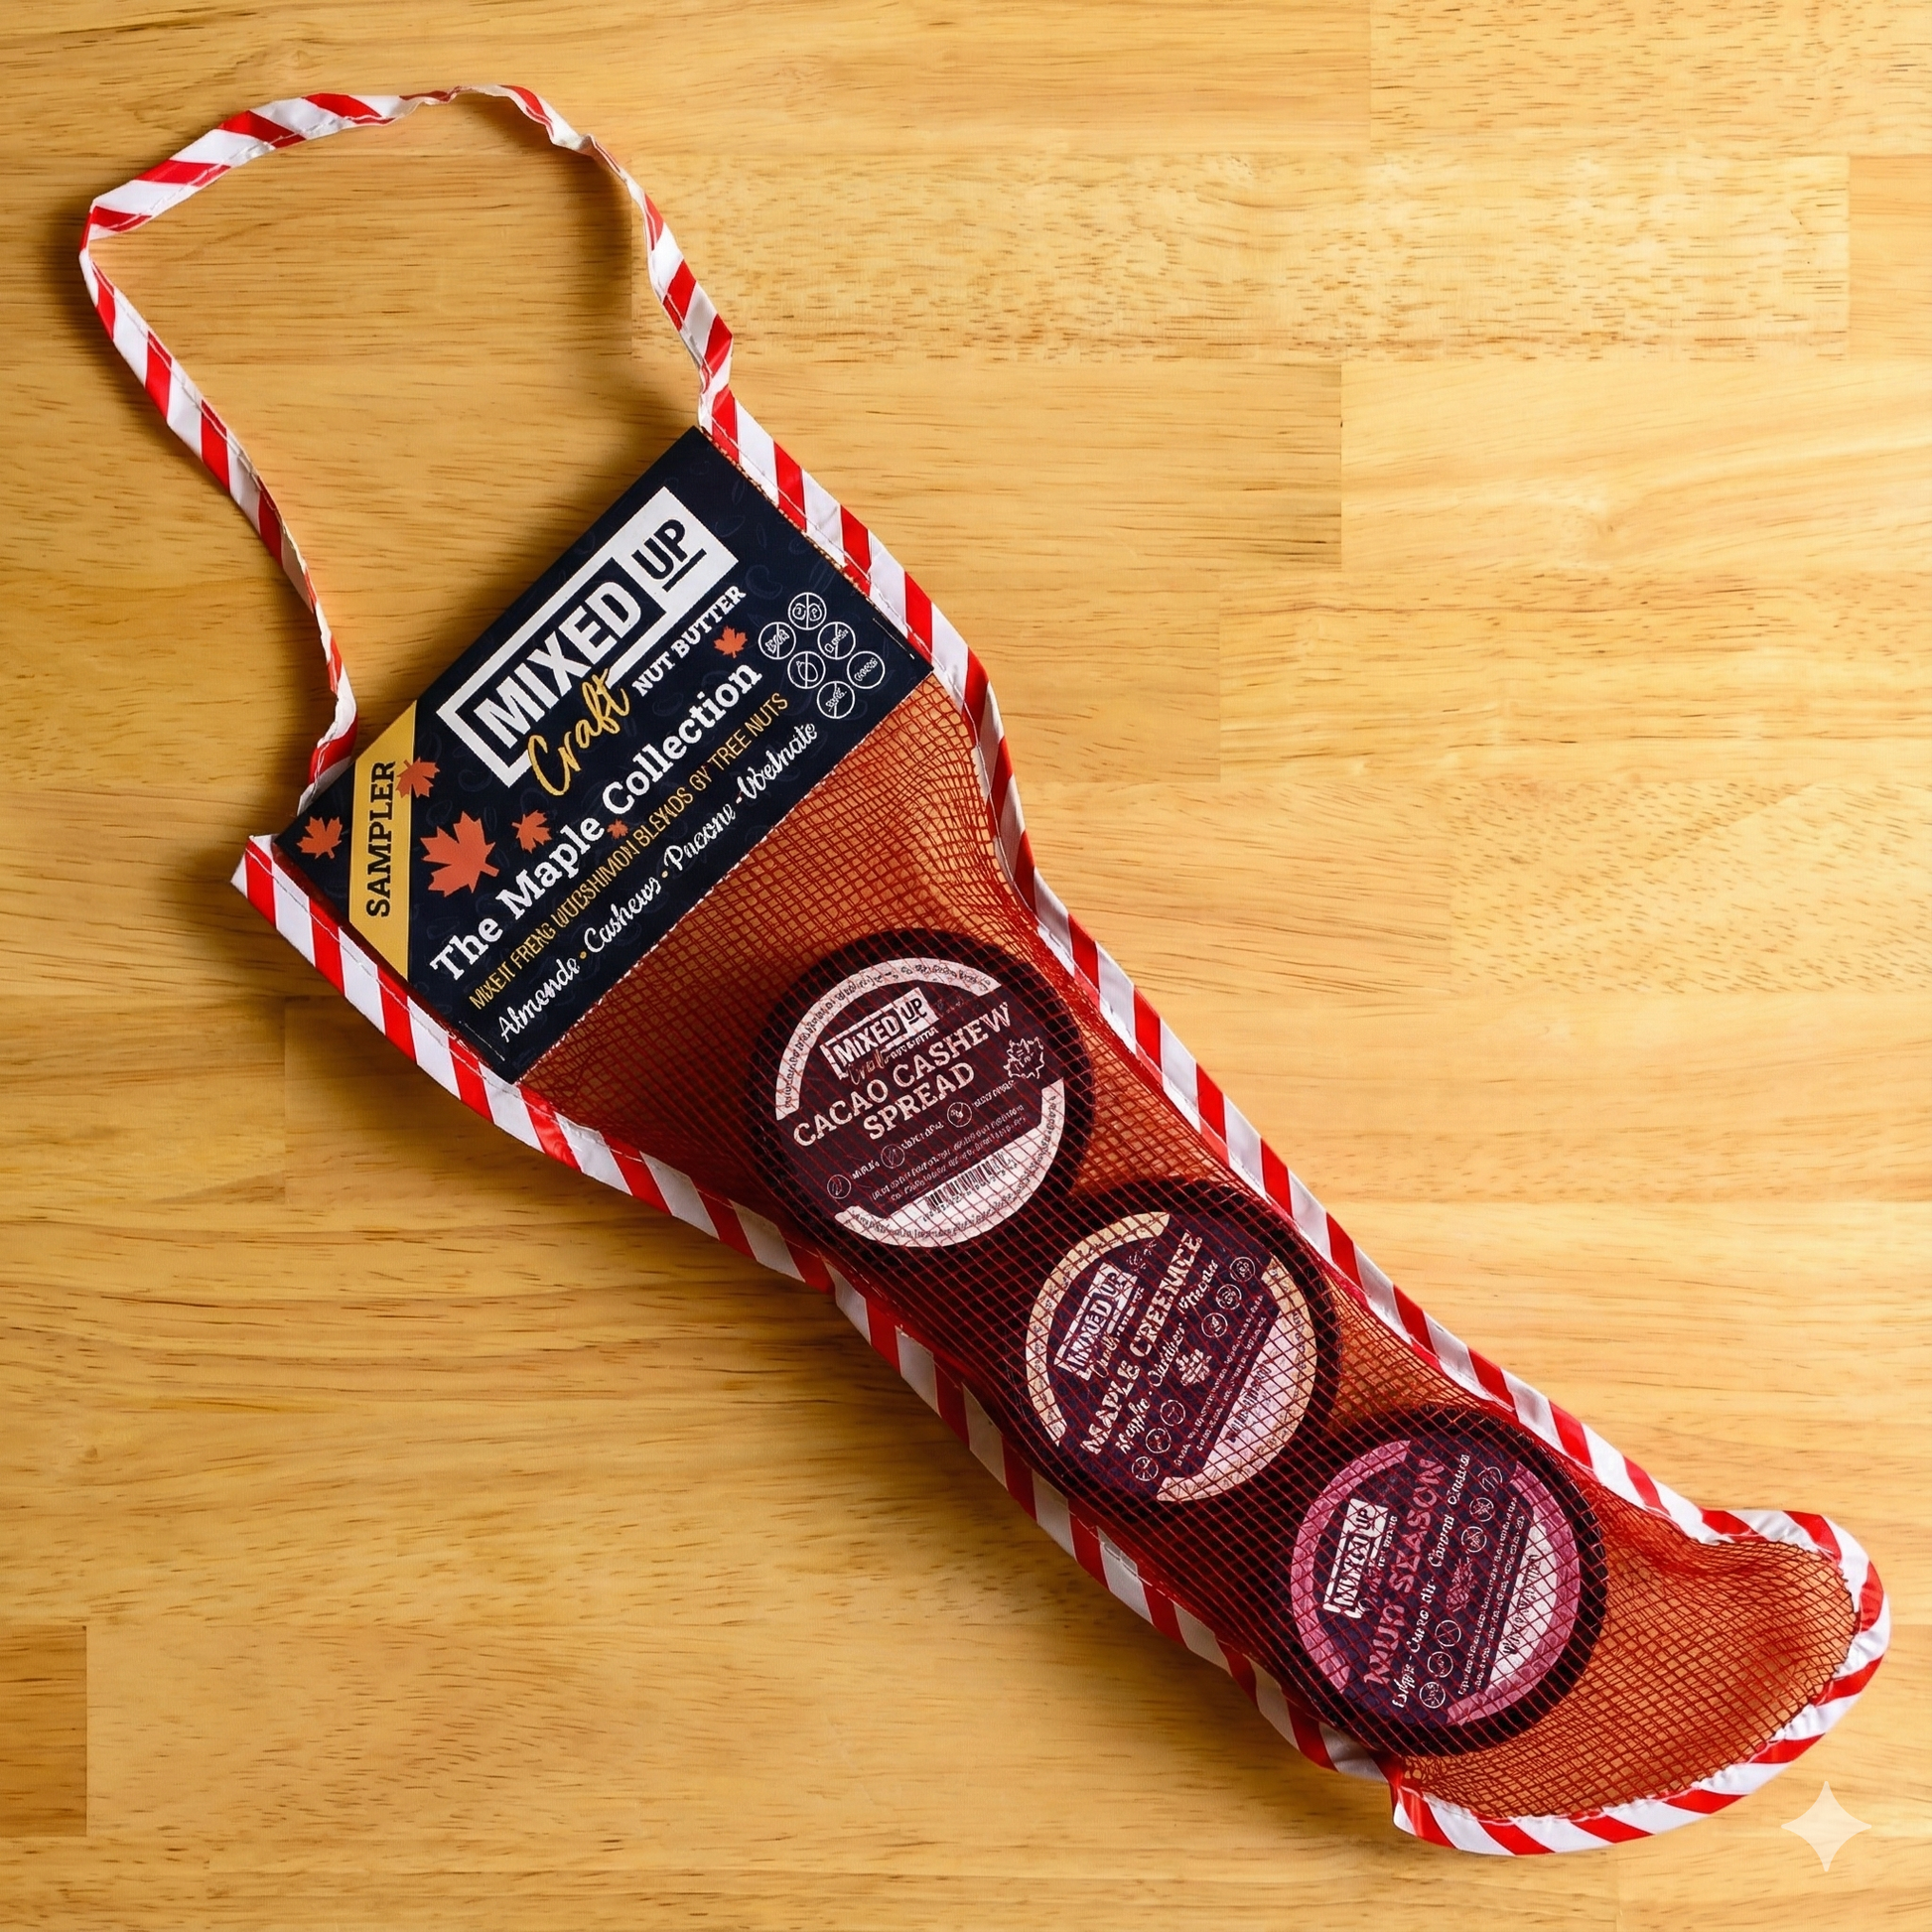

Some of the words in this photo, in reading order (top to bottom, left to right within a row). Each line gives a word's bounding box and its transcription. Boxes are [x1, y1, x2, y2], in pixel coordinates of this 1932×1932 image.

[473, 582, 640, 749] MIXED
[630, 519, 687, 579] UP
[527, 675, 628, 795] Craft
[631, 650, 675, 696] NUT
[670, 585, 746, 658] BUTTER
[706, 729, 752, 769] TREE
[744, 692, 787, 737] NUTS
[365, 760, 395, 916] SAMPLER
[429, 917, 502, 980] The
[495, 817, 604, 919] Maple
[602, 664, 761, 814] Collection
[793, 1078, 888, 1146] CACAO
[893, 1001, 1010, 1087] CASHEW
[900, 998, 921, 1020] UP
[863, 1062, 974, 1139] SPREAD
[1079, 1359, 1140, 1454] MAPLE
[1388, 1457, 1444, 1592] SEASON
